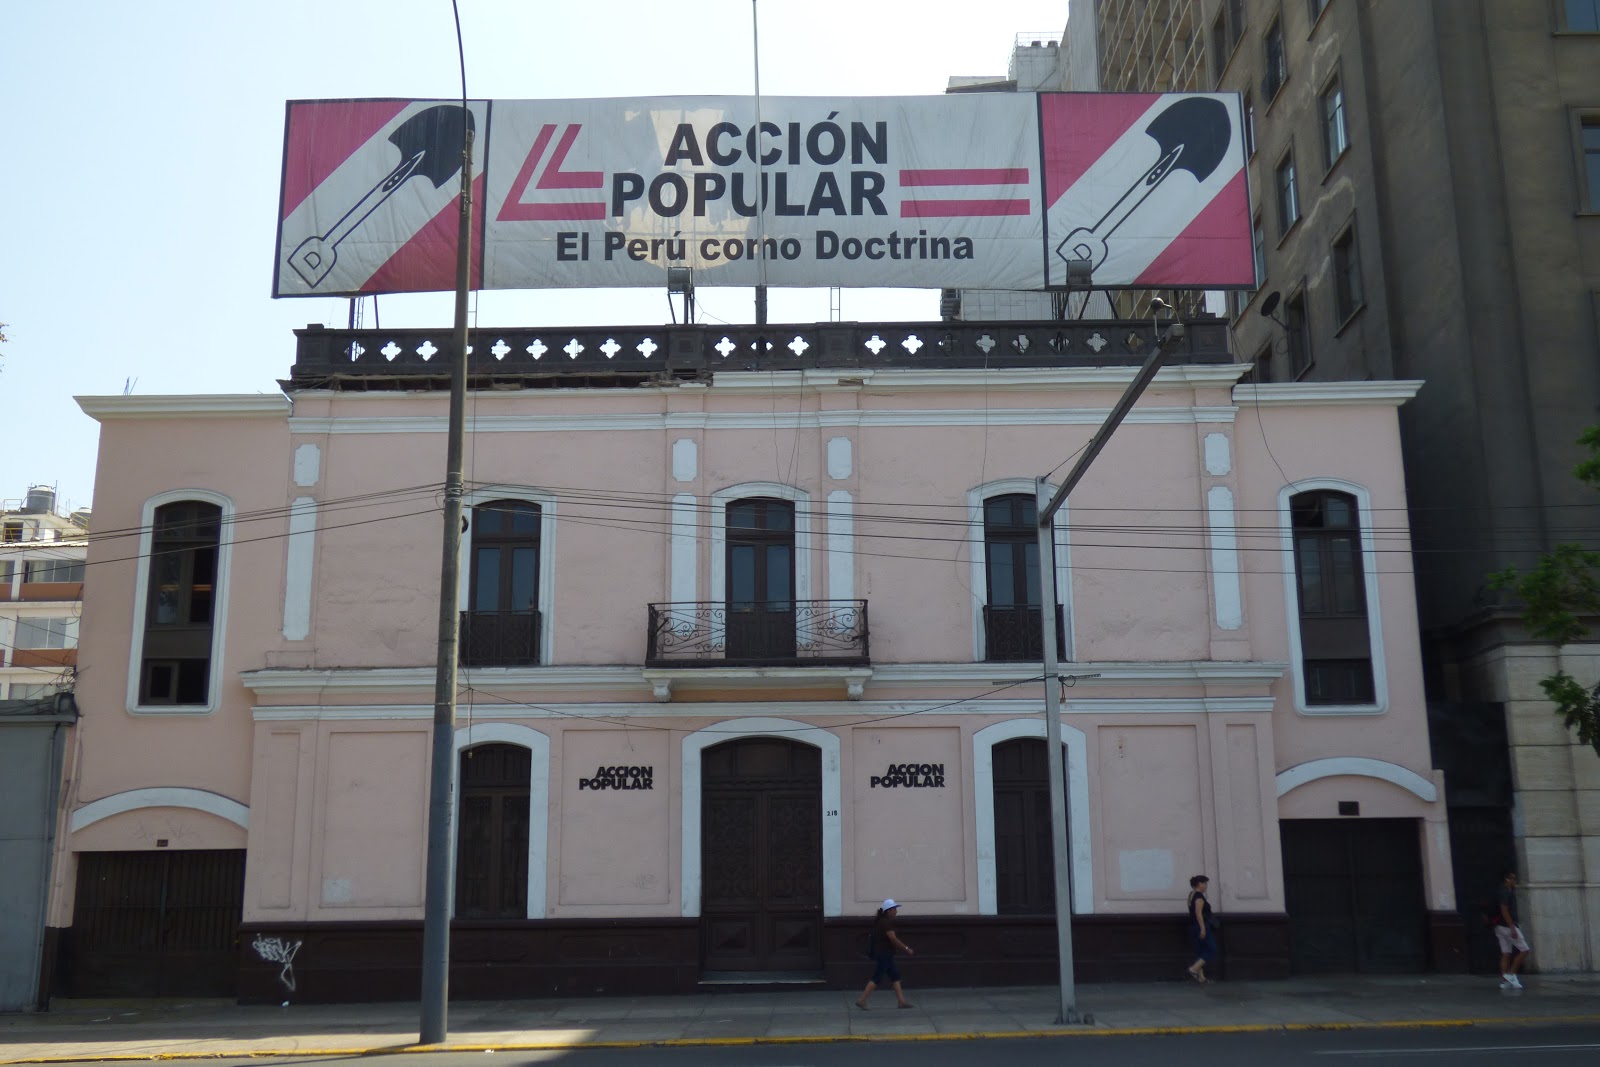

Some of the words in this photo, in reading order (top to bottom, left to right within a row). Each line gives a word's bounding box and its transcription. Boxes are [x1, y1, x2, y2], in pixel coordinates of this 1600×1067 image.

[664, 111, 888, 167] ACCIÓN
[611, 170, 889, 218] POPULAR
[556, 231, 589, 262] El
[604, 230, 687, 262] Perú
[699, 236, 802, 262] como
[815, 229, 975, 261] Doctrina
[595, 766, 653, 778] ACCION
[887, 763, 945, 776] ACCION
[578, 778, 654, 790] POPULAR
[870, 776, 946, 788] POPULAR
